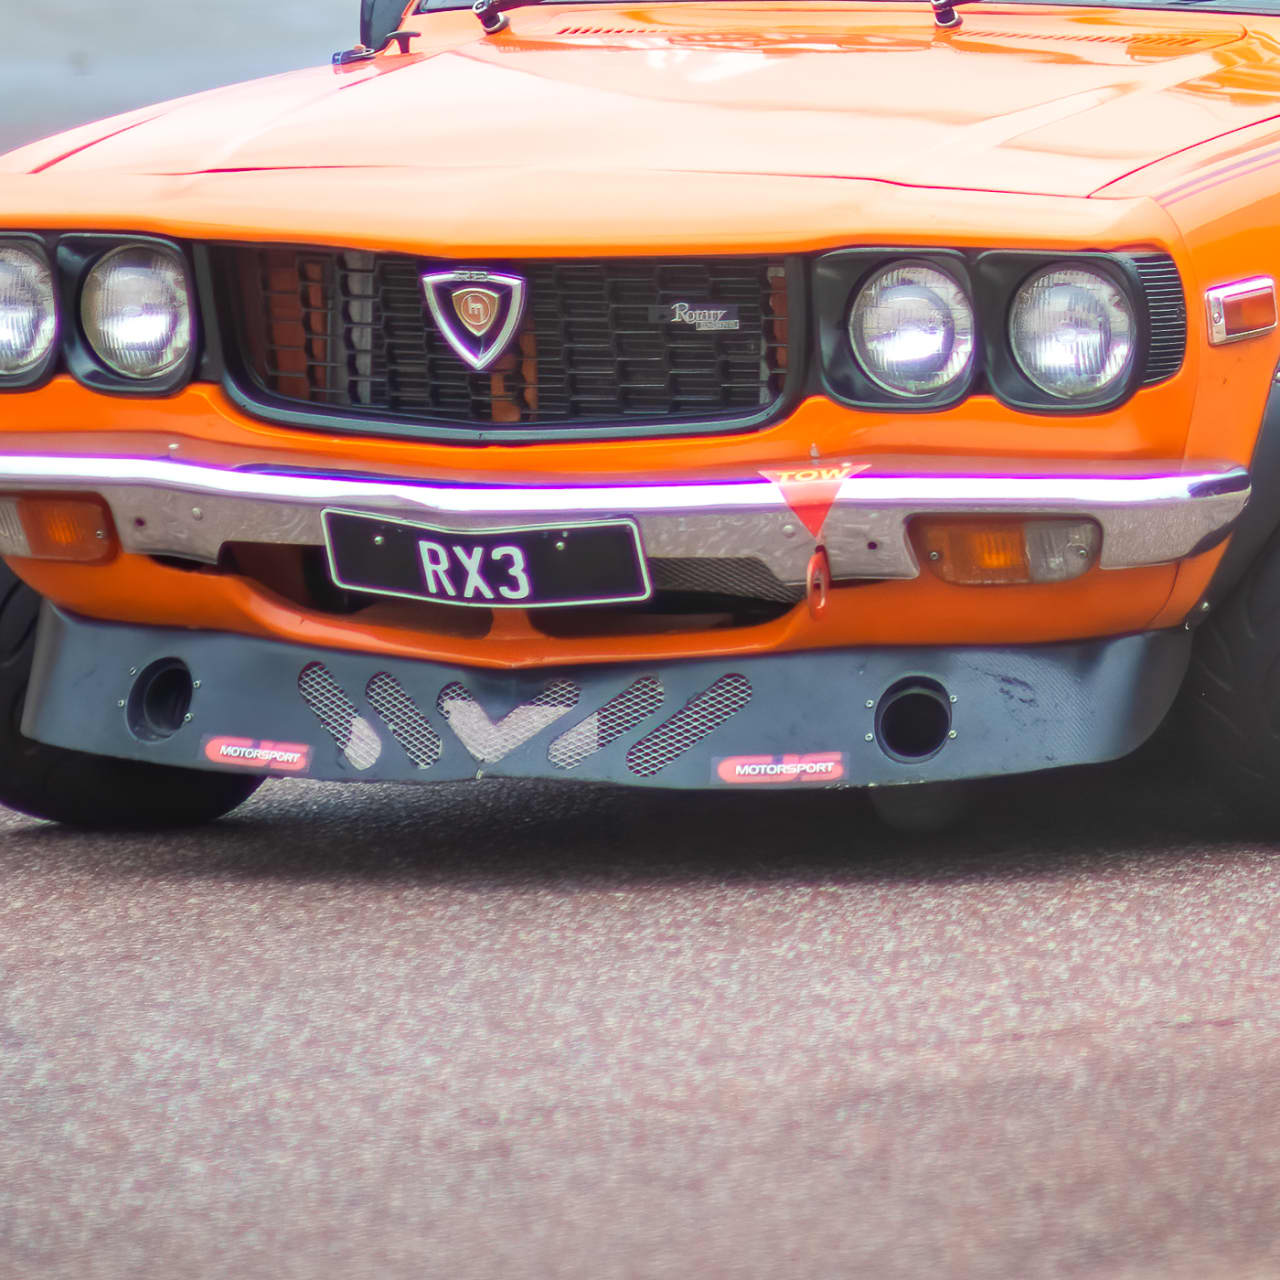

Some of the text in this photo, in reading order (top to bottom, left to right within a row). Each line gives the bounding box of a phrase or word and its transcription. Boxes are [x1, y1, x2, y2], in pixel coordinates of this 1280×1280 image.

[776, 467, 851, 483] TOW
[418, 540, 530, 599] RX3
[220, 745, 301, 762] MOTORSPORT
[735, 762, 835, 775] MOTORSPORT
